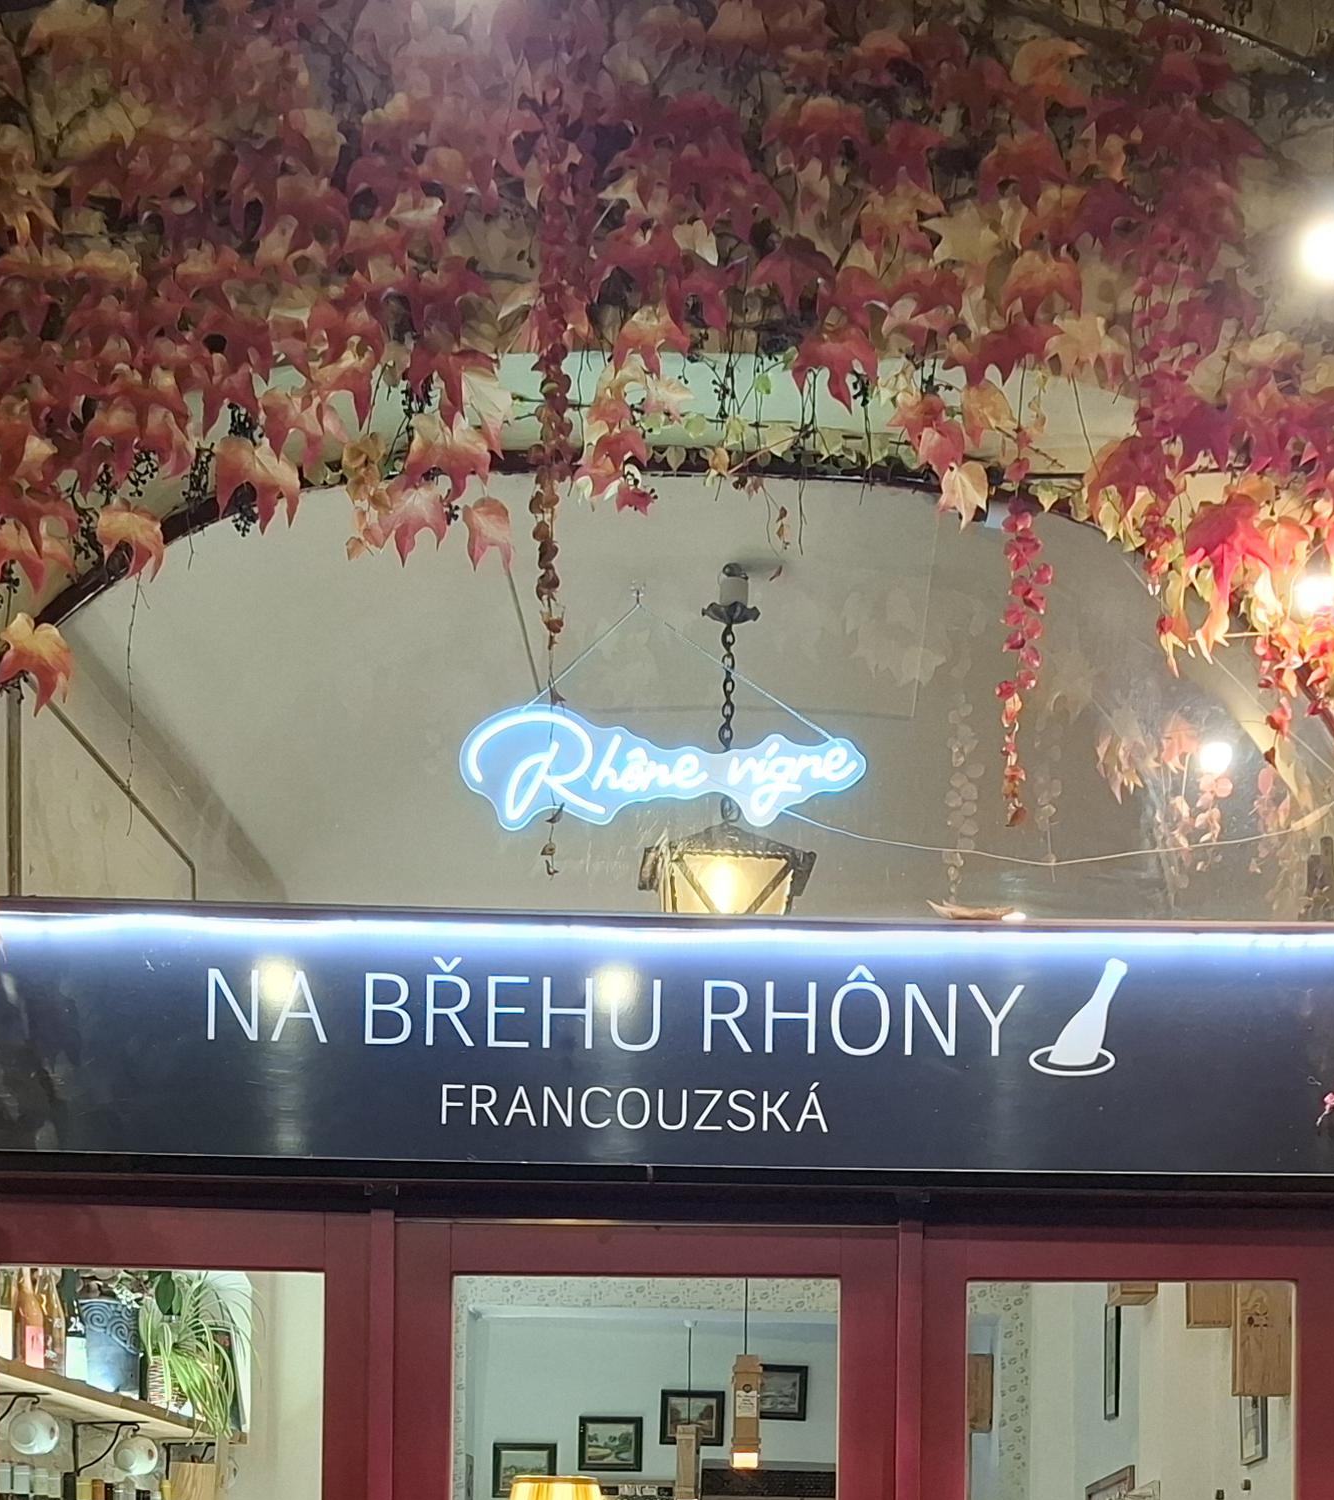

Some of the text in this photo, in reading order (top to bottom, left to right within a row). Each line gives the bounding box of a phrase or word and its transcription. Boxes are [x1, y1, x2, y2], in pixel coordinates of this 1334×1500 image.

[206, 956, 1025, 1057] NA BŘEHU RHÔNY
[439, 1081, 829, 1133] FRANCOUZSKÁ
